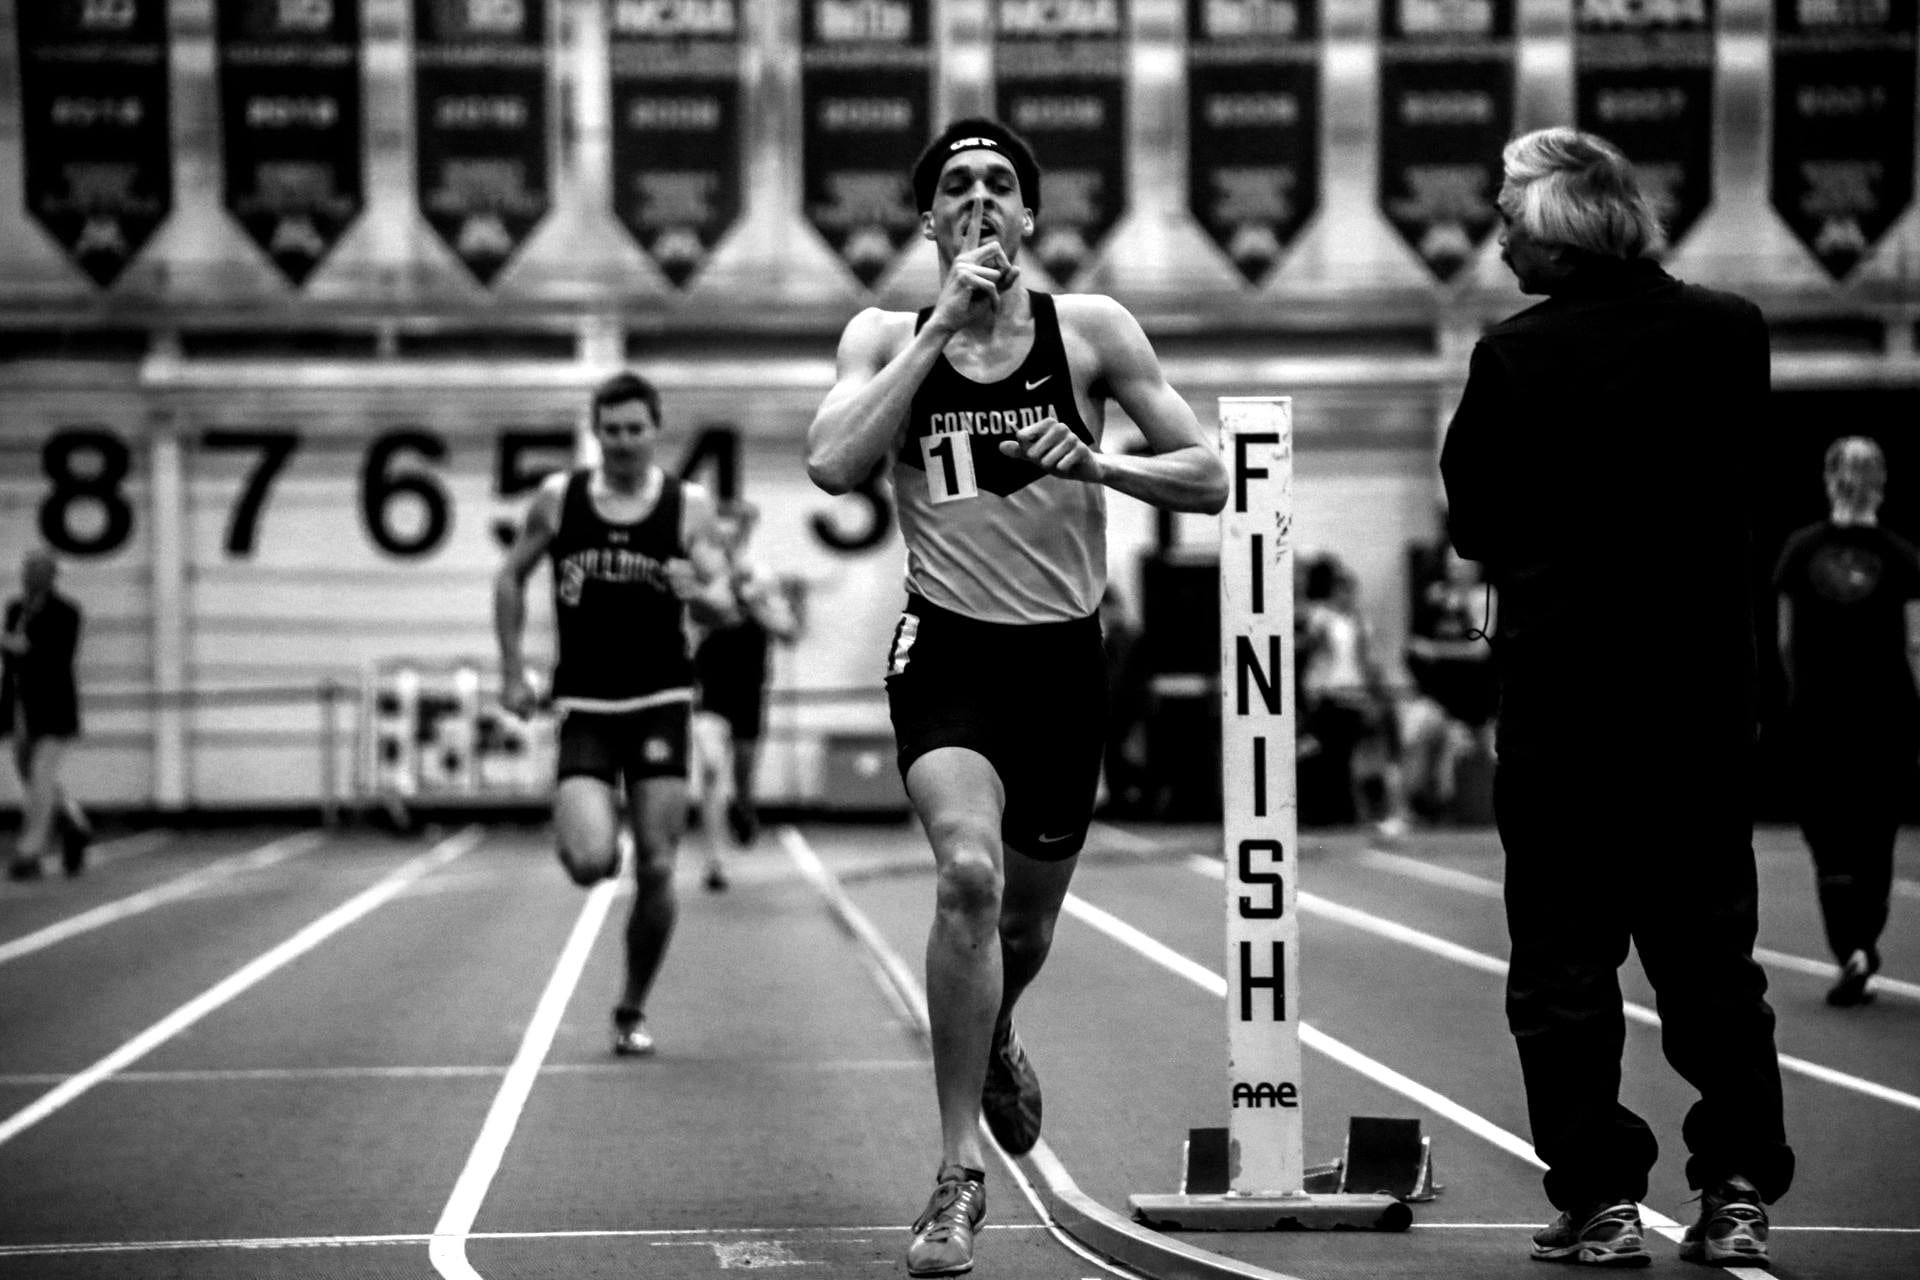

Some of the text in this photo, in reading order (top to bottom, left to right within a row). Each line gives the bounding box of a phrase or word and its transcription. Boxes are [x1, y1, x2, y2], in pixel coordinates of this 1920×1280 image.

[929, 436, 960, 497] 1
[931, 404, 1060, 436] CONCORDIA
[39, 428, 133, 557] 8
[202, 430, 301, 557] 7
[360, 429, 453, 560] 6
[1235, 433, 1286, 1022] FINISH
